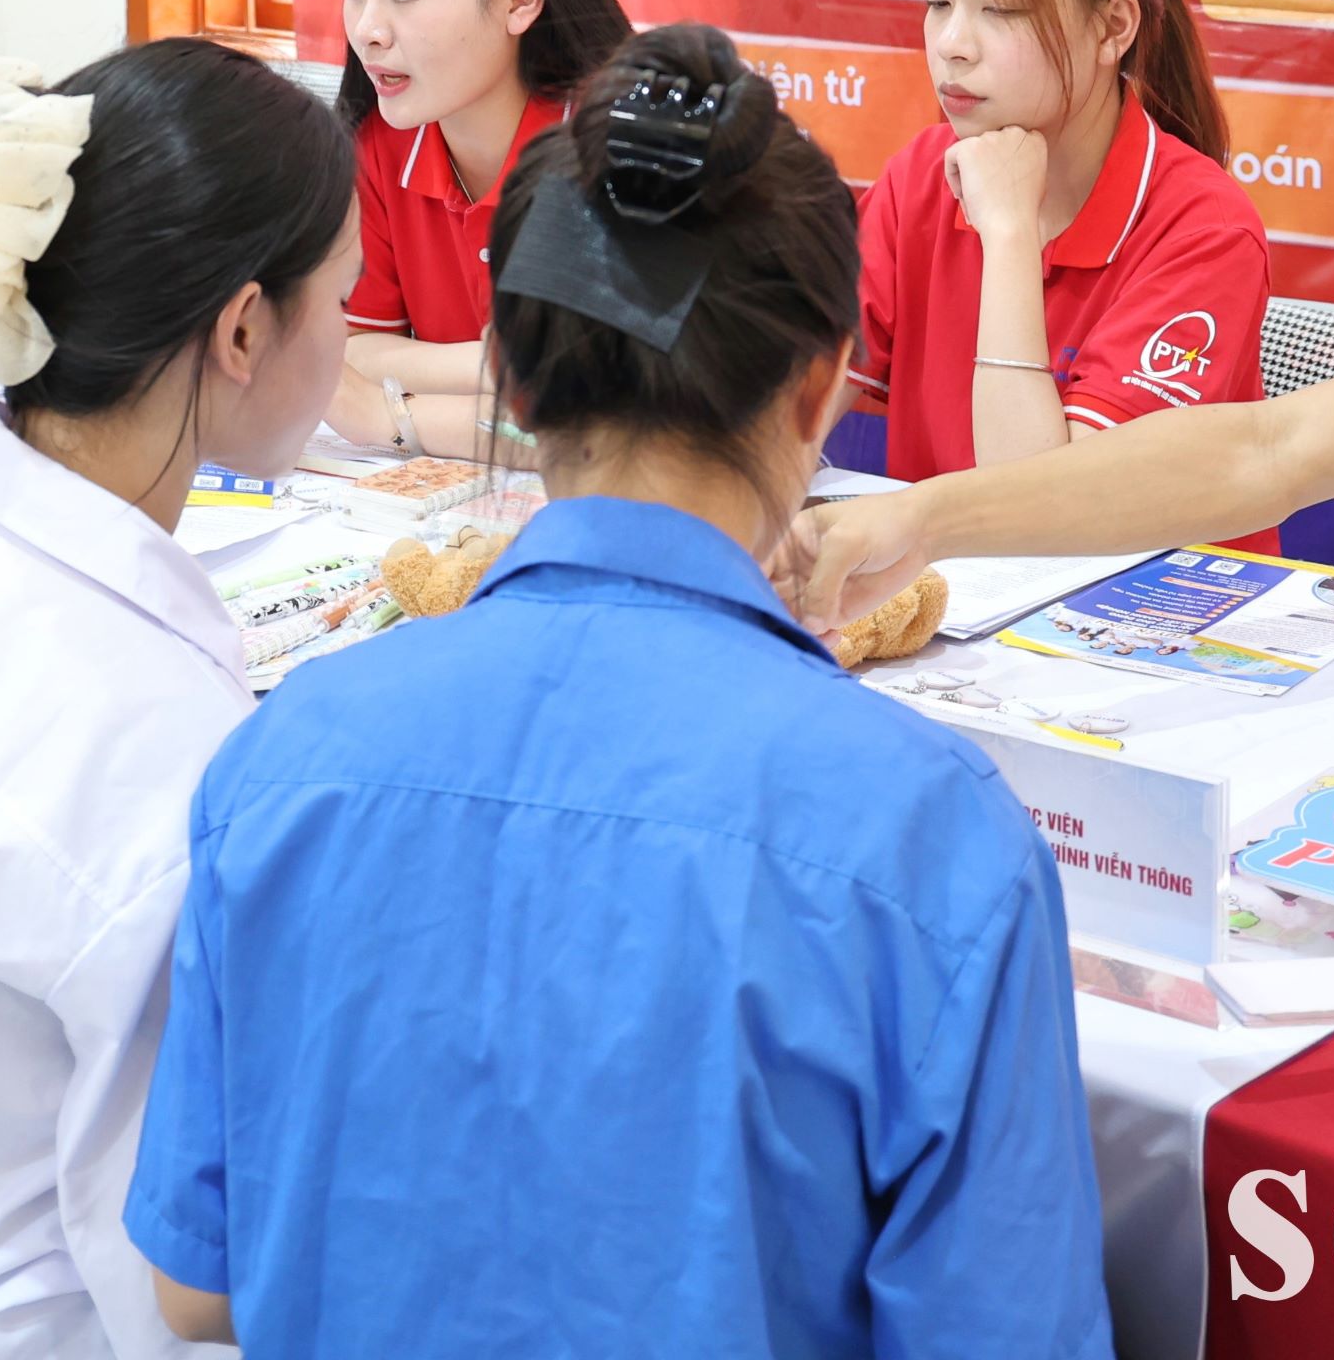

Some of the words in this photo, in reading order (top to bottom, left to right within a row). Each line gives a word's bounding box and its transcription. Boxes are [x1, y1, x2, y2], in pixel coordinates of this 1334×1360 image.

[743, 56, 813, 108] iện
[823, 65, 866, 107] tử
[1229, 146, 1323, 190] oán
[1047, 812, 1083, 839] VIỆN
[1094, 852, 1132, 881] VIỄN
[1137, 865, 1193, 897] THÔNG
